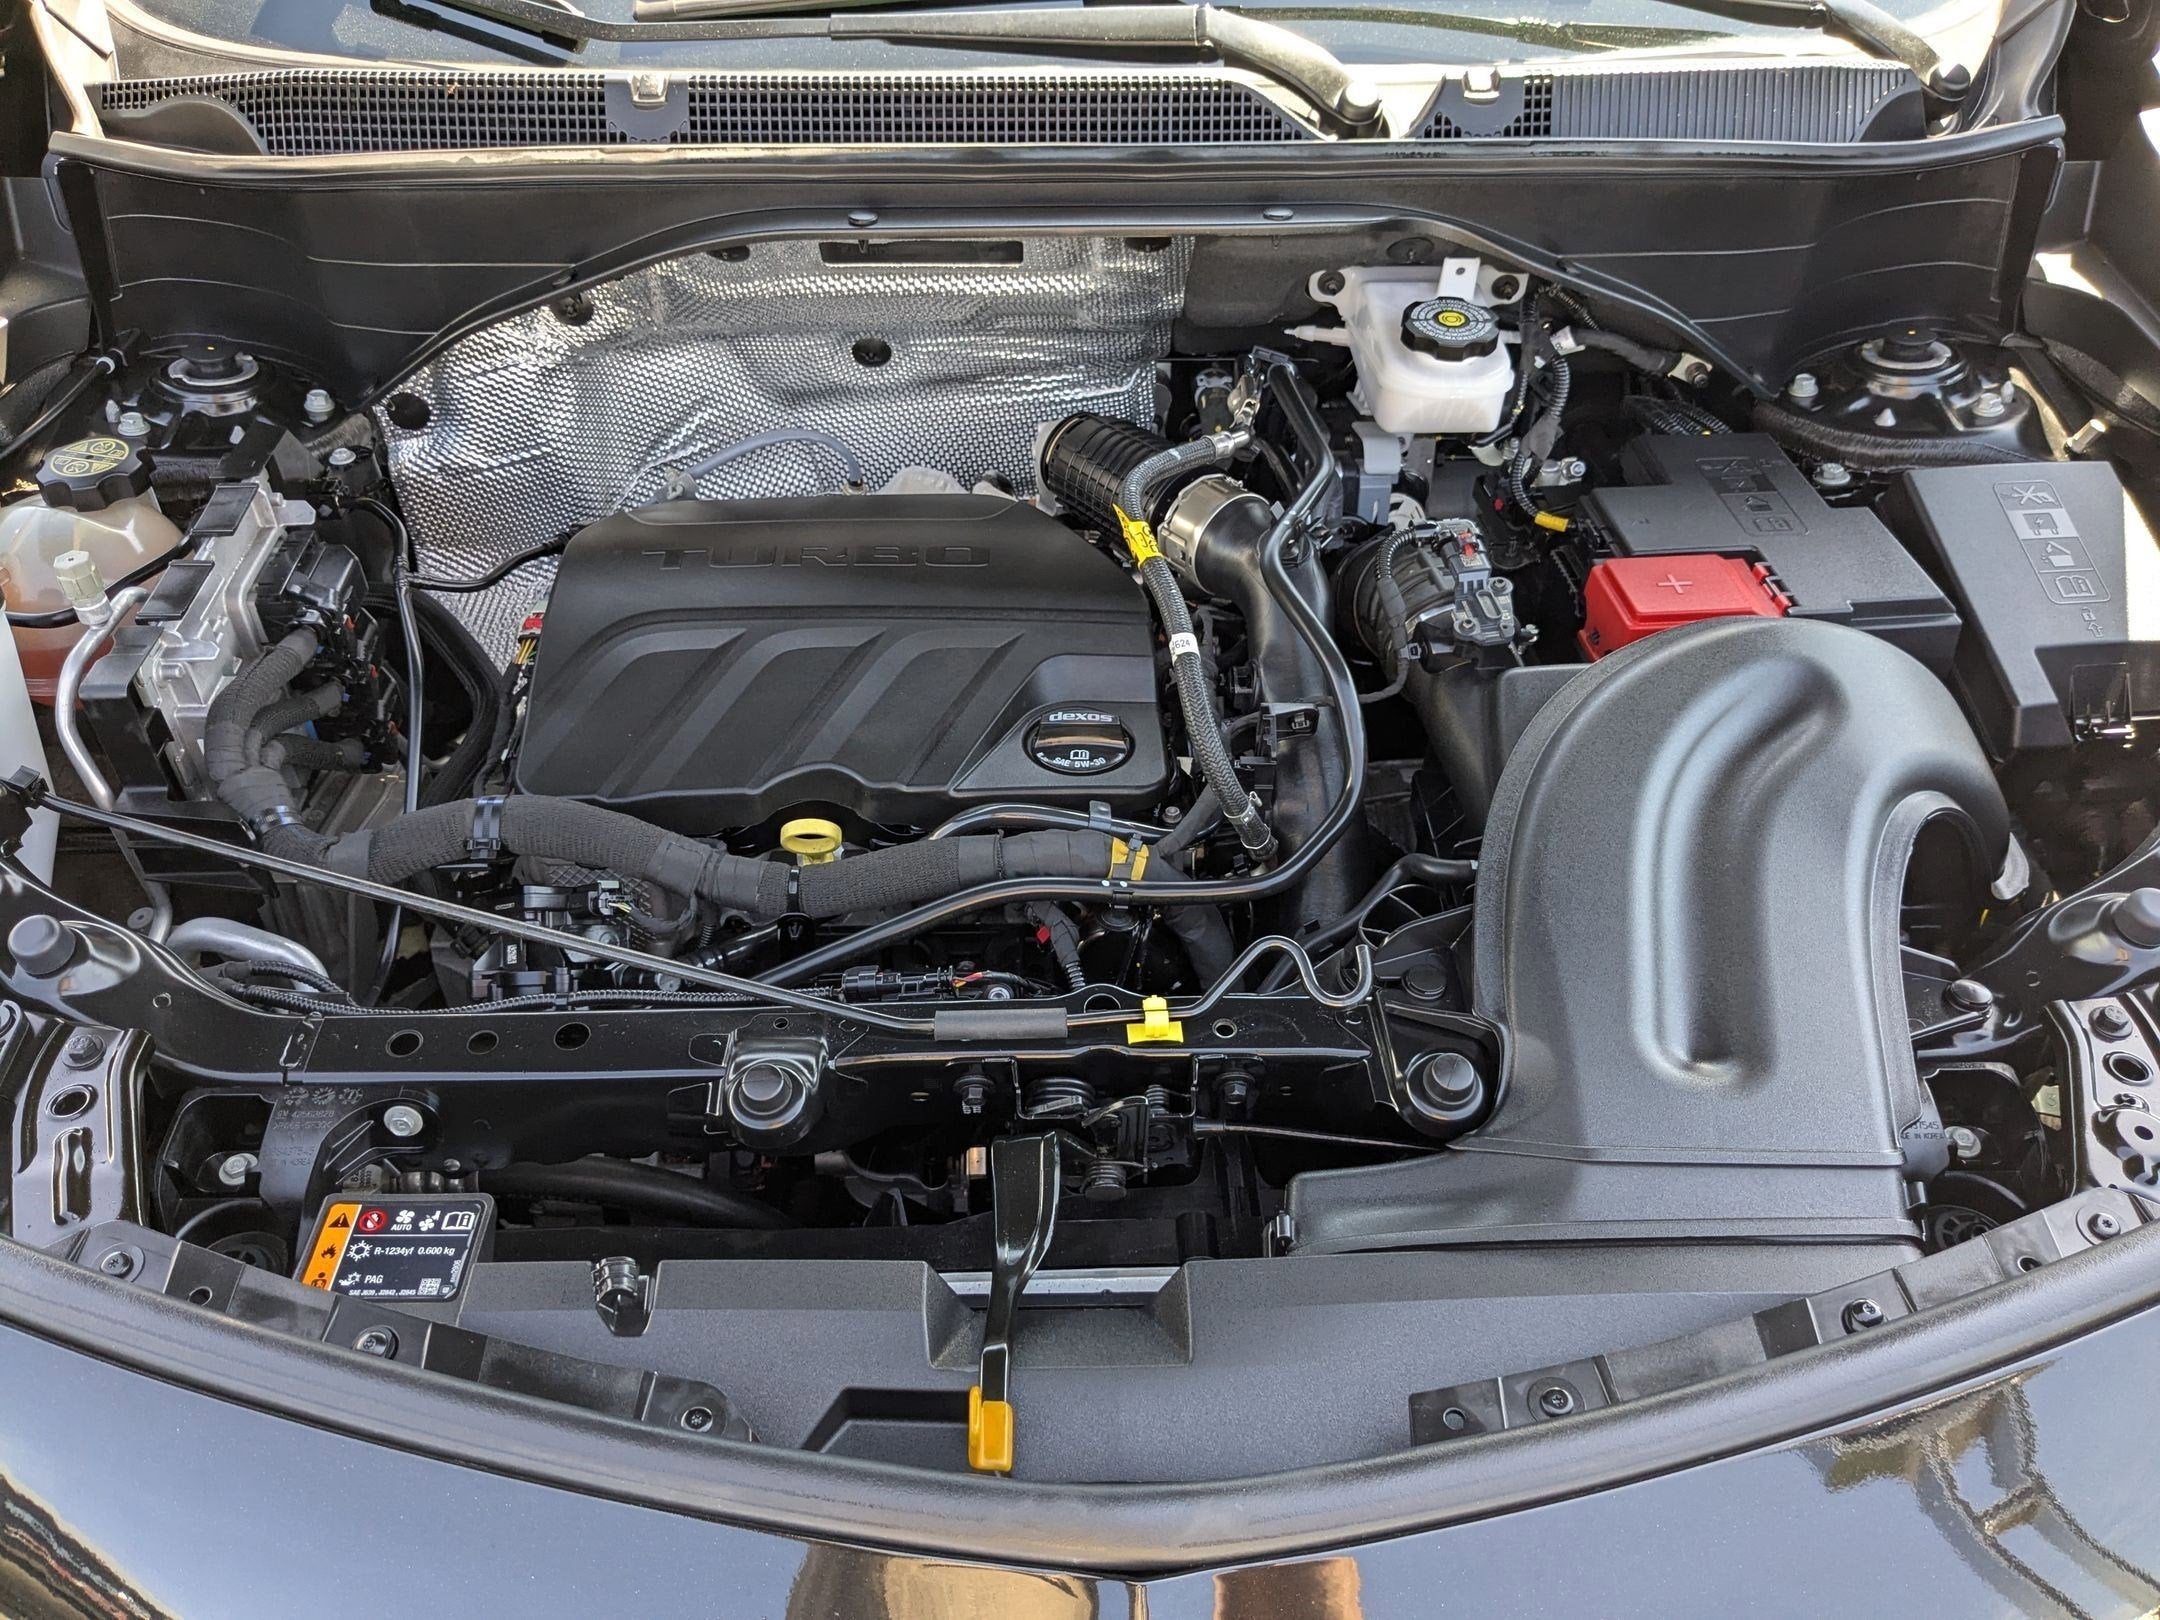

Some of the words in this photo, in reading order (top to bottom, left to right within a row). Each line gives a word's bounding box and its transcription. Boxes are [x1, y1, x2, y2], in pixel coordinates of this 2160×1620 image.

[641, 545, 991, 570] TURBO
[1048, 711, 1114, 722] dexos
[1053, 757, 1071, 767] SAE
[1074, 757, 1106, 768] 5W-30
[373, 1247, 414, 1256] R-1234yf
[417, 1247, 442, 1255] 0.600
[443, 1247, 456, 1256] kg
[364, 1274, 384, 1284] PAG
